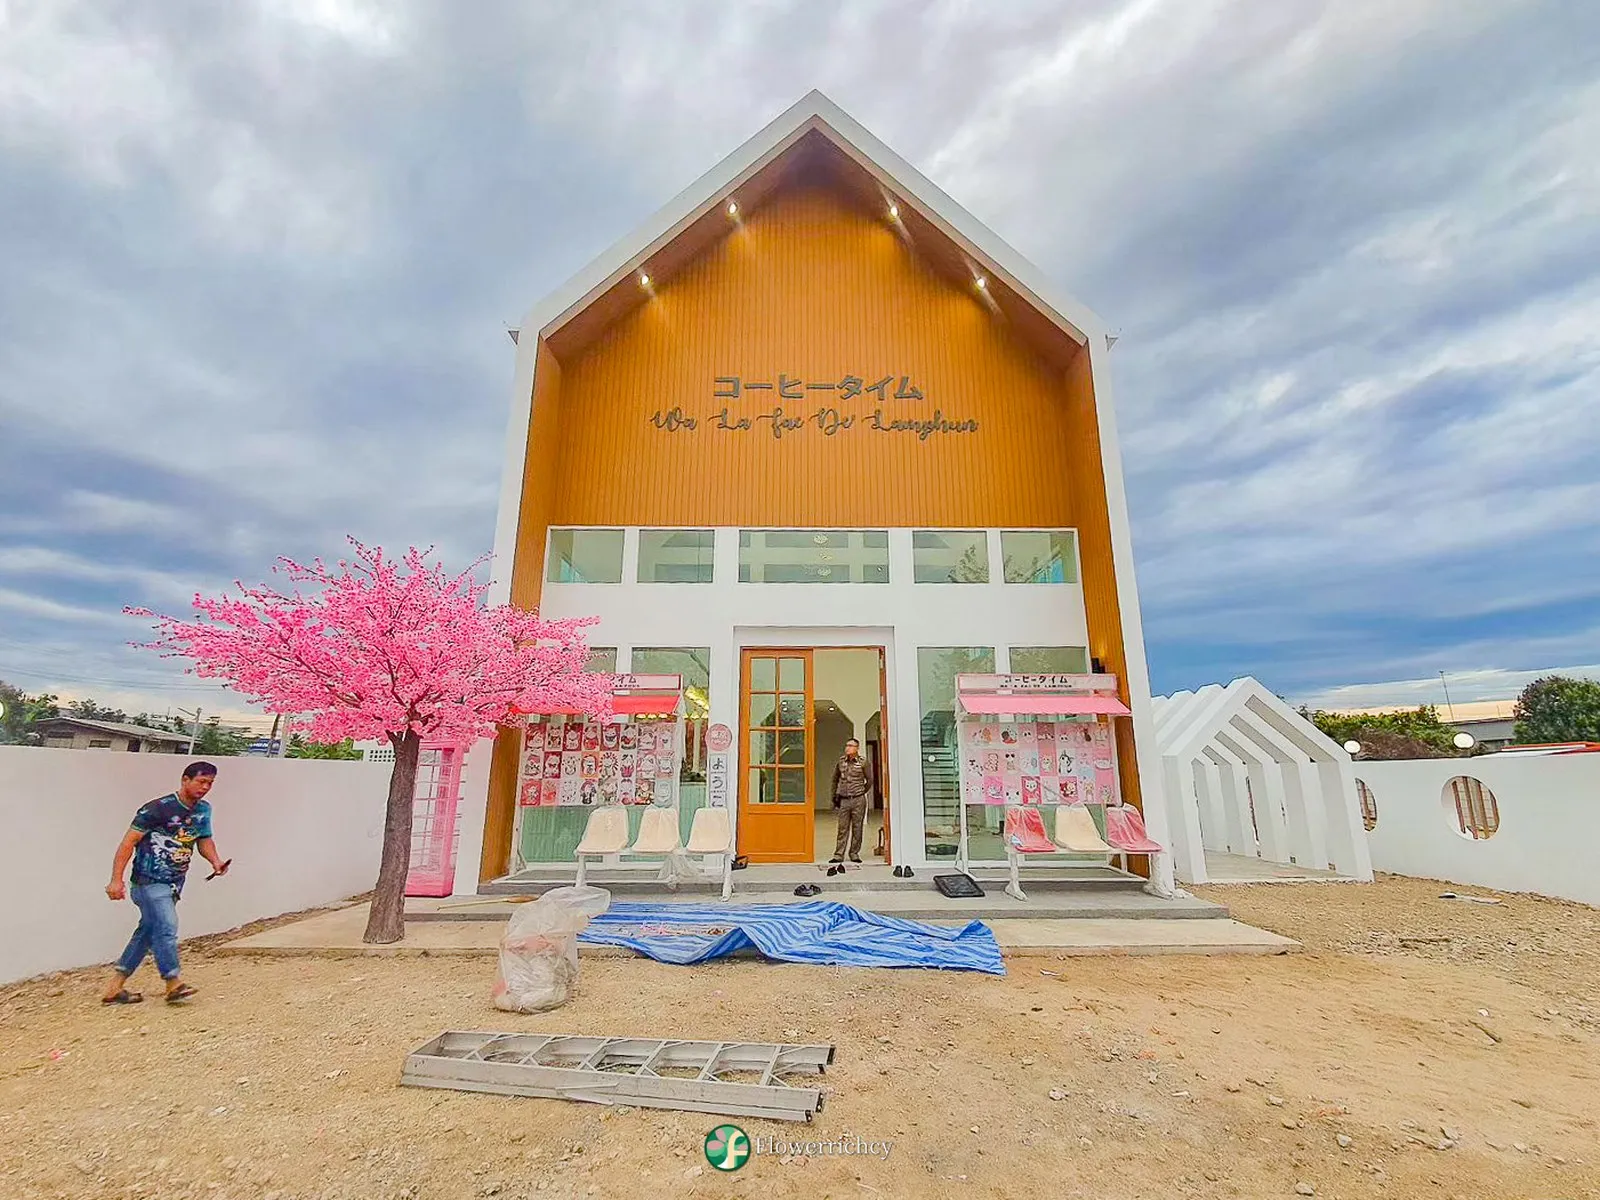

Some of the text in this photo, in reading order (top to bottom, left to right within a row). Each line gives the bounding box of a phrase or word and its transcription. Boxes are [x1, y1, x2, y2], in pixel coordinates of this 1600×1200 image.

[714, 374, 923, 400] コーヒータイム
